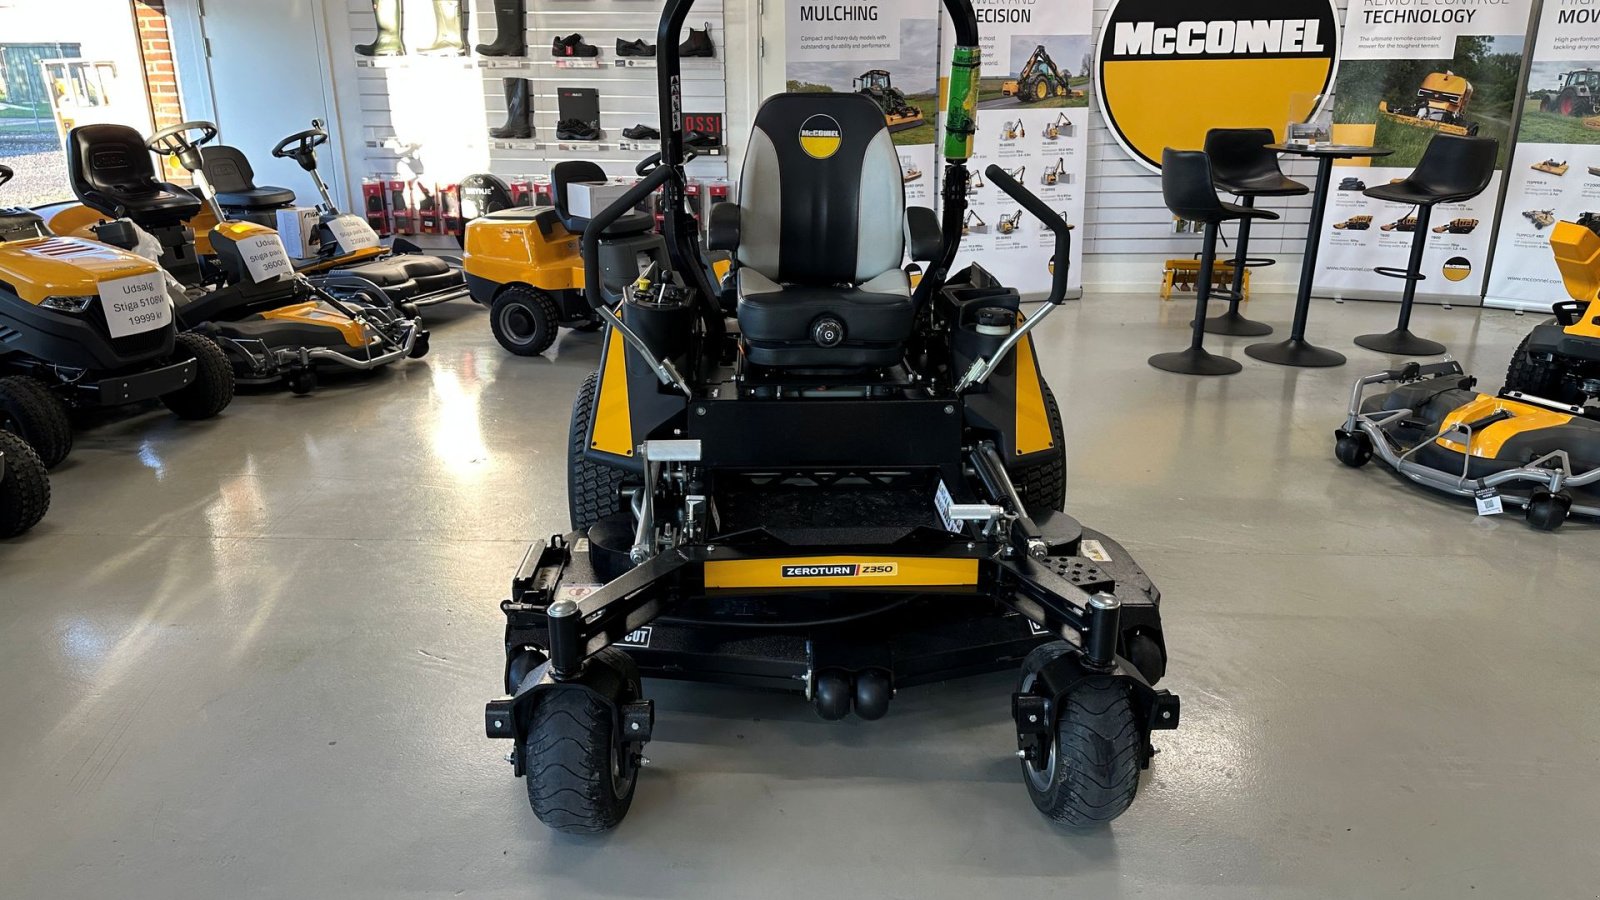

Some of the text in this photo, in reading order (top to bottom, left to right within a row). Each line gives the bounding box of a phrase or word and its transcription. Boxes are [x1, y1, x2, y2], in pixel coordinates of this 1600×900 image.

[800, 5, 878, 21] MULCHING
[1363, 9, 1477, 24] TECHNOLOGY
[250, 252, 268, 263] Stiga
[262, 259, 287, 271] 36000
[122, 282, 154, 294] Udsalg
[113, 301, 139, 312] Stiga
[128, 311, 162, 325] 19999 kr
[787, 566, 850, 576] ZEROTURN
